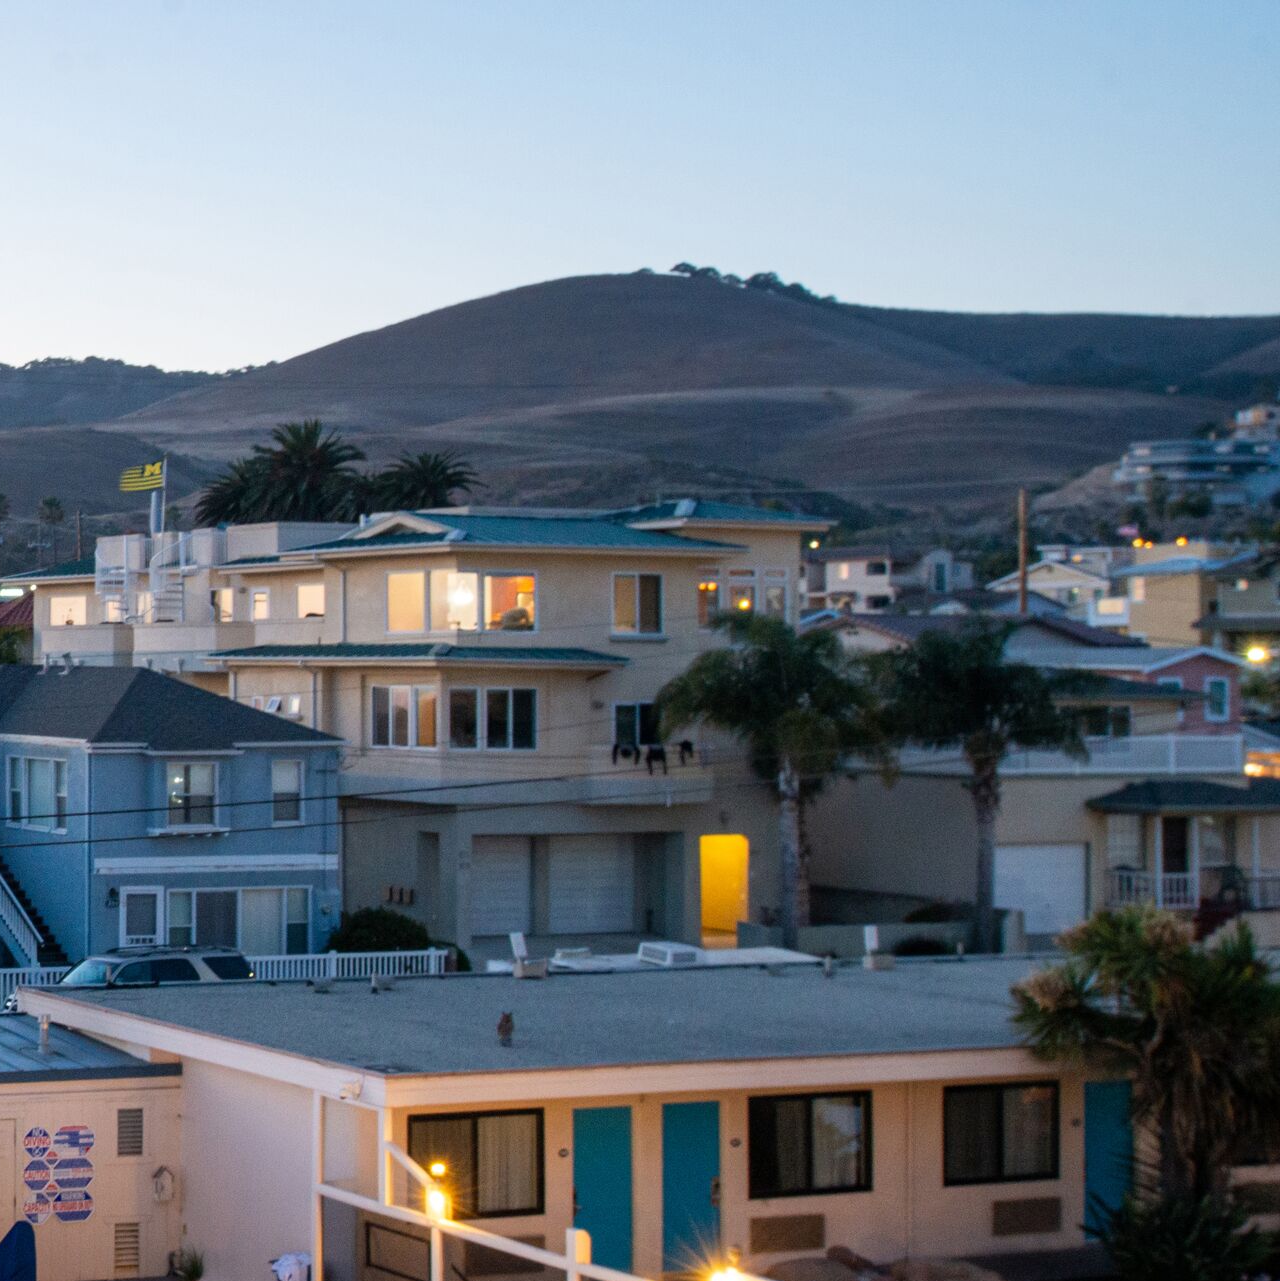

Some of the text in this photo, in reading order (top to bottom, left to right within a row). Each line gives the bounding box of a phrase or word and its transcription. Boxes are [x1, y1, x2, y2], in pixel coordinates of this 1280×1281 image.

[144, 462, 161, 477] M
[31, 1127, 44, 1137] NO
[23, 1136, 51, 1148] DIVING
